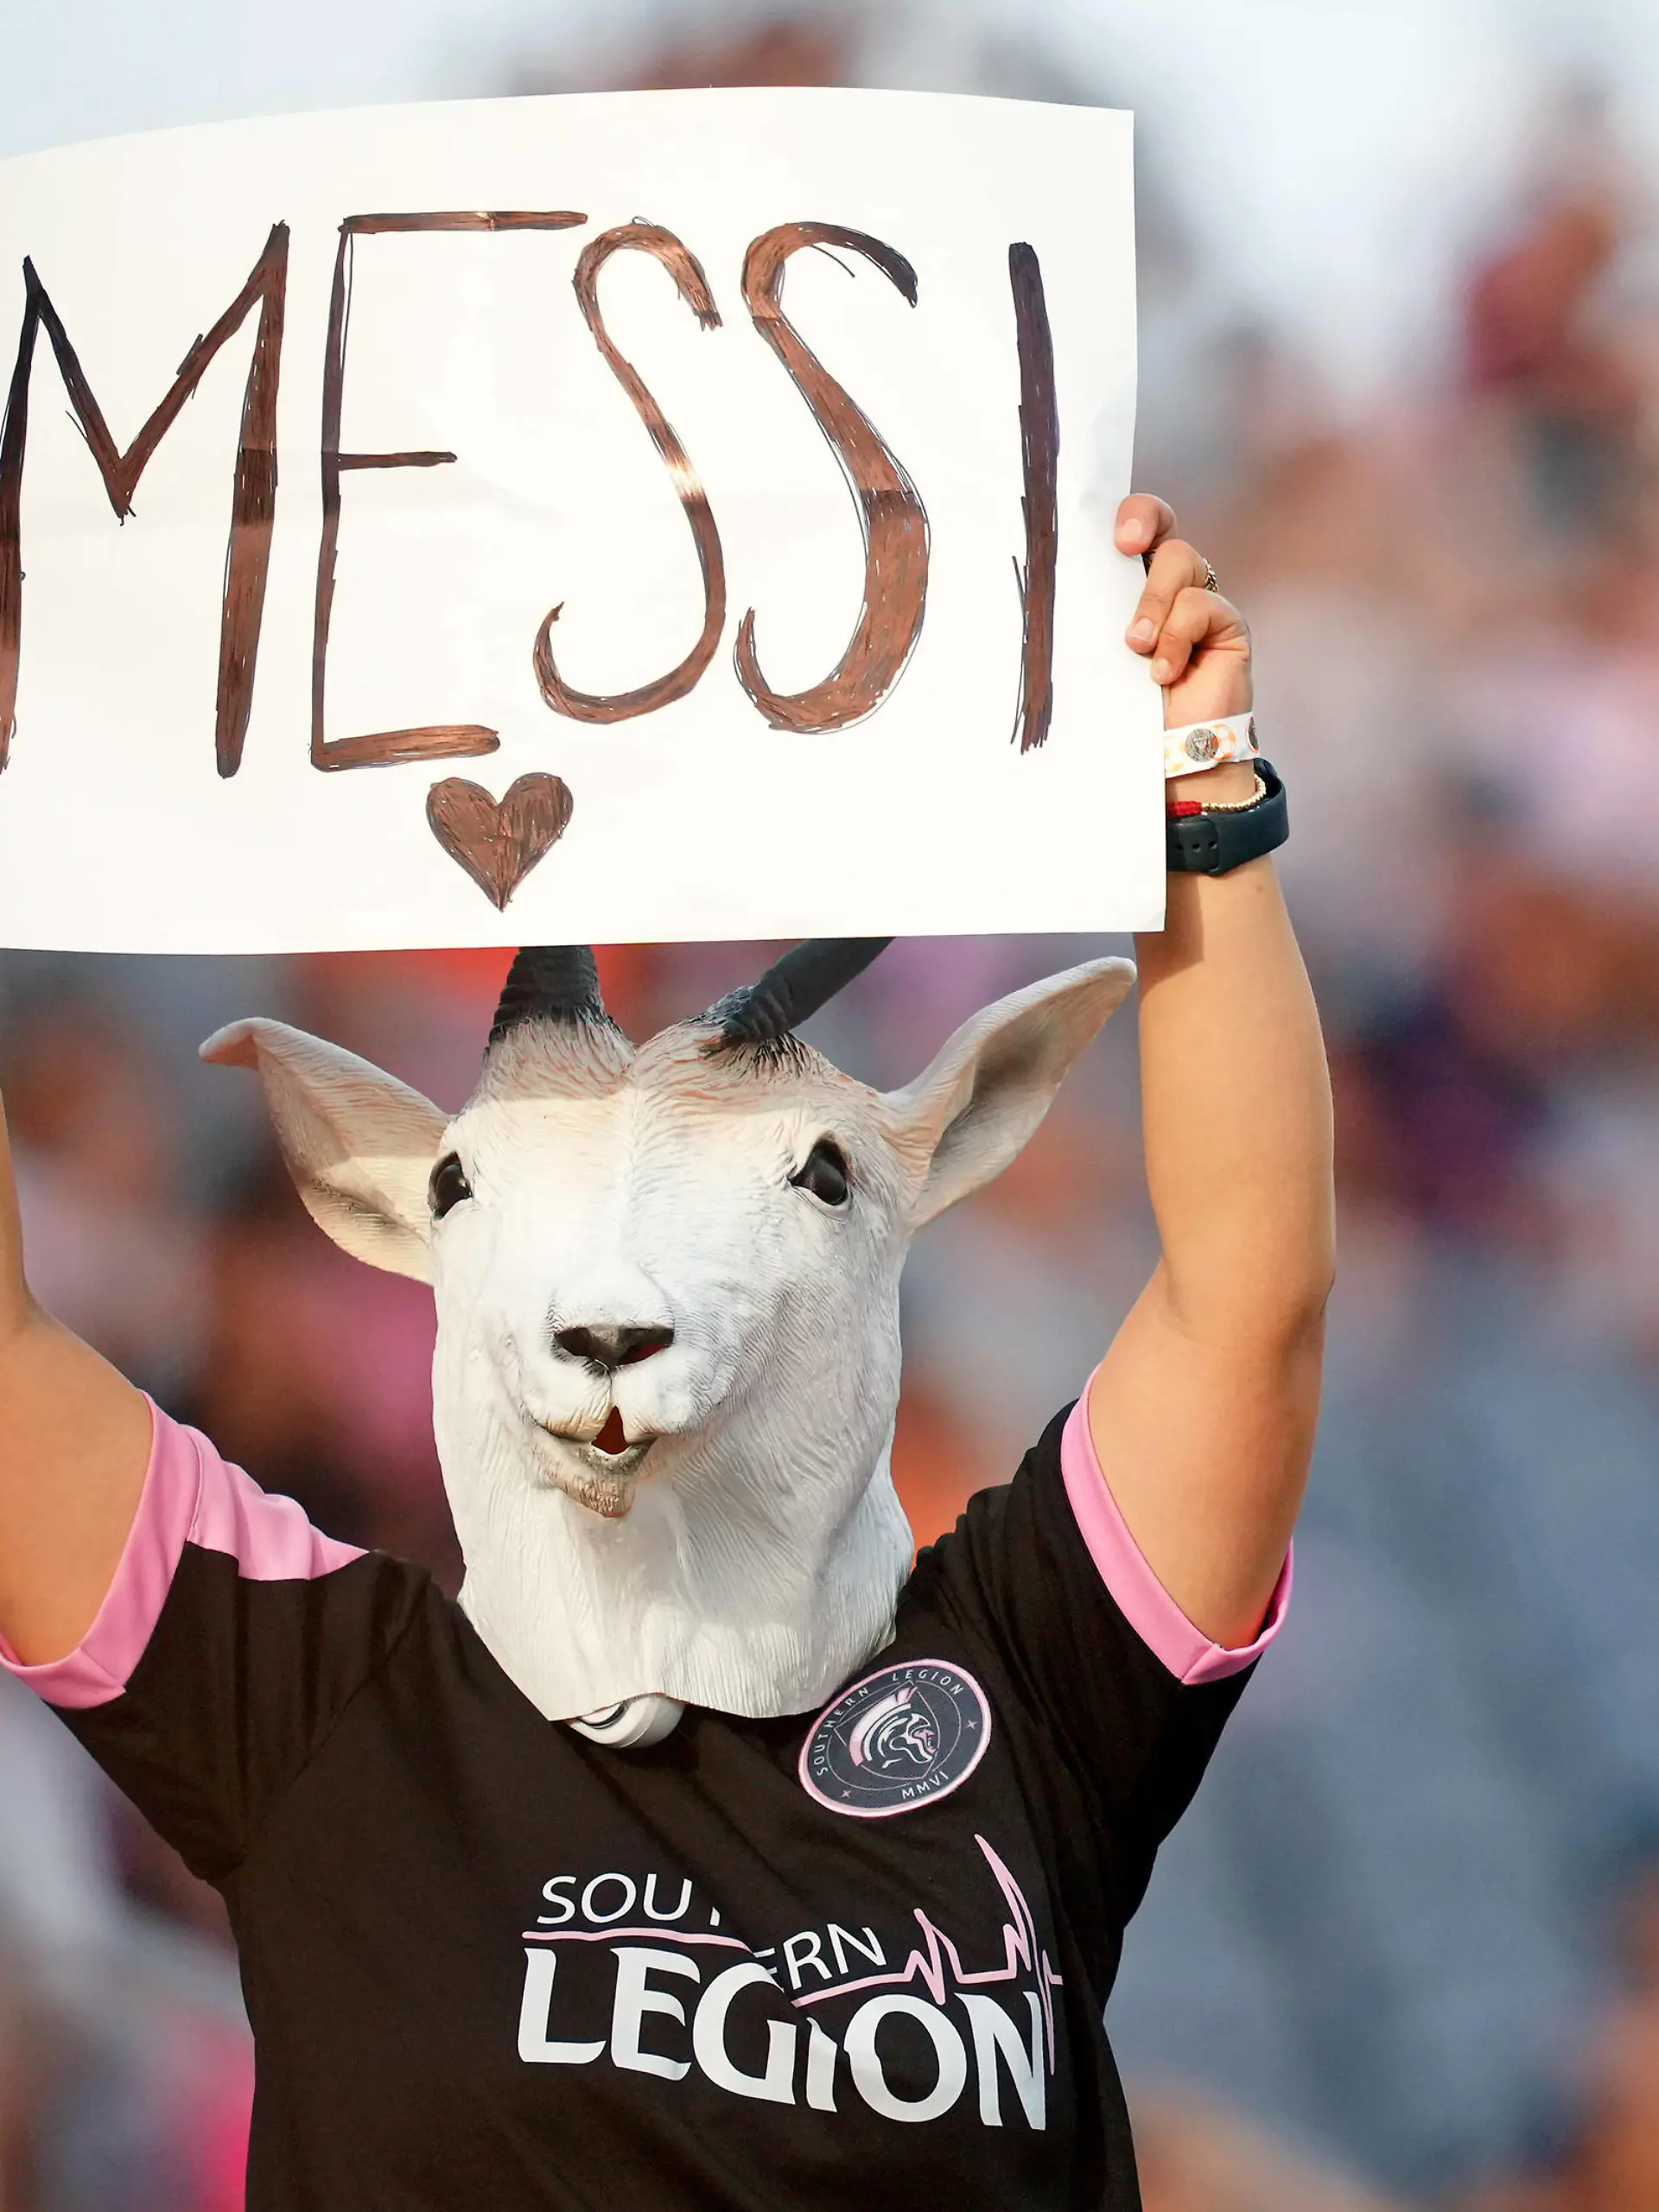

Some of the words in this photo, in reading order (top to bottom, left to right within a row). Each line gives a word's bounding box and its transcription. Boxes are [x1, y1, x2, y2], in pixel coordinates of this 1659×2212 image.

[0, 211, 1058, 779] MESSI
[812, 1688, 870, 1777] SOUTHERN
[892, 1669, 964, 1696] LEGION
[901, 1770, 950, 1800] MMVI
[518, 1948, 1046, 2132] LEGION
